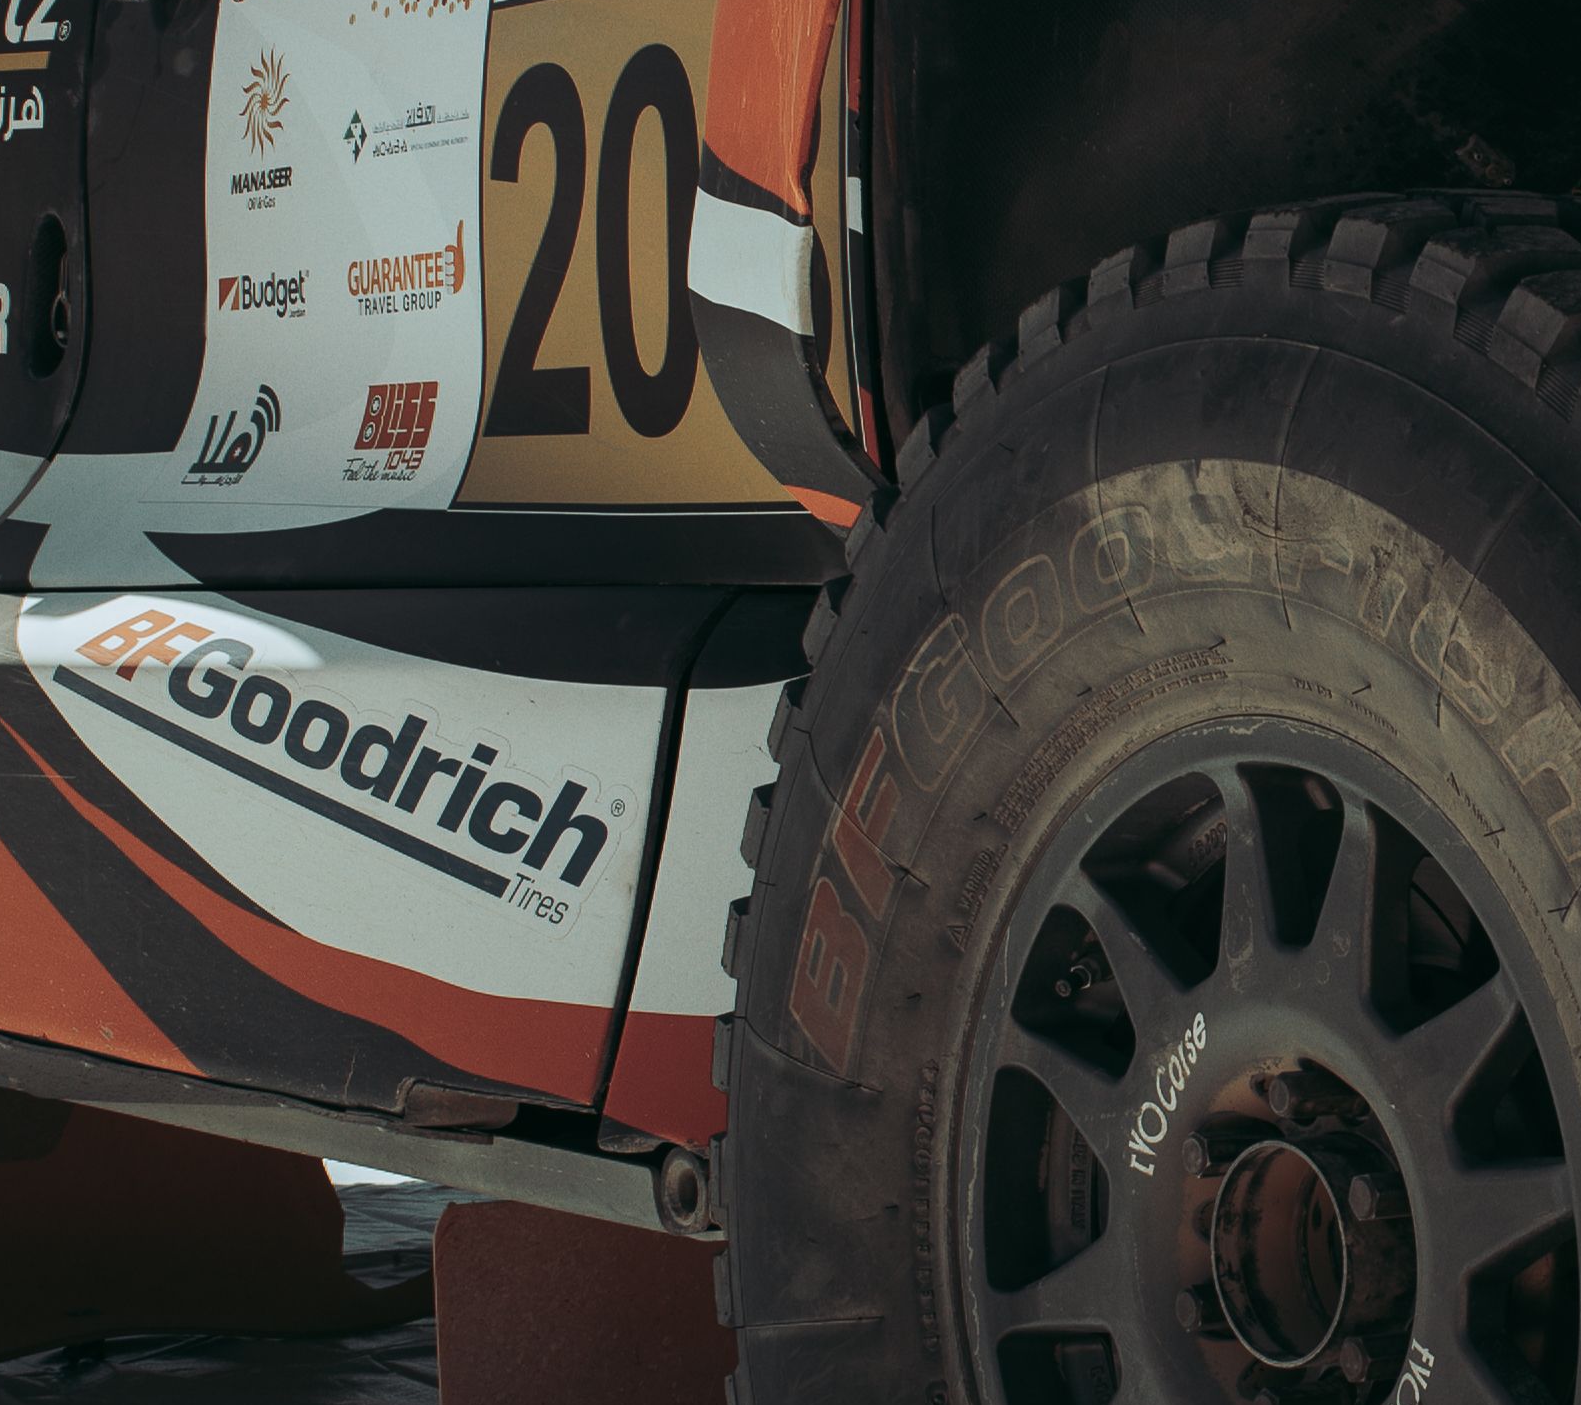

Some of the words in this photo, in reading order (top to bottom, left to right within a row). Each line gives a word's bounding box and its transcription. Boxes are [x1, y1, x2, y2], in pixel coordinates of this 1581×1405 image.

[231, 166, 292, 195] MANASEER
[483, 43, 701, 438] 20
[241, 270, 306, 318] Budget
[348, 251, 444, 296] GUARANTEE
[358, 292, 399, 316] TRAVEL
[402, 290, 442, 312] GROUP
[75, 607, 610, 889] BFGoodrich
[505, 872, 569, 926] Tires
